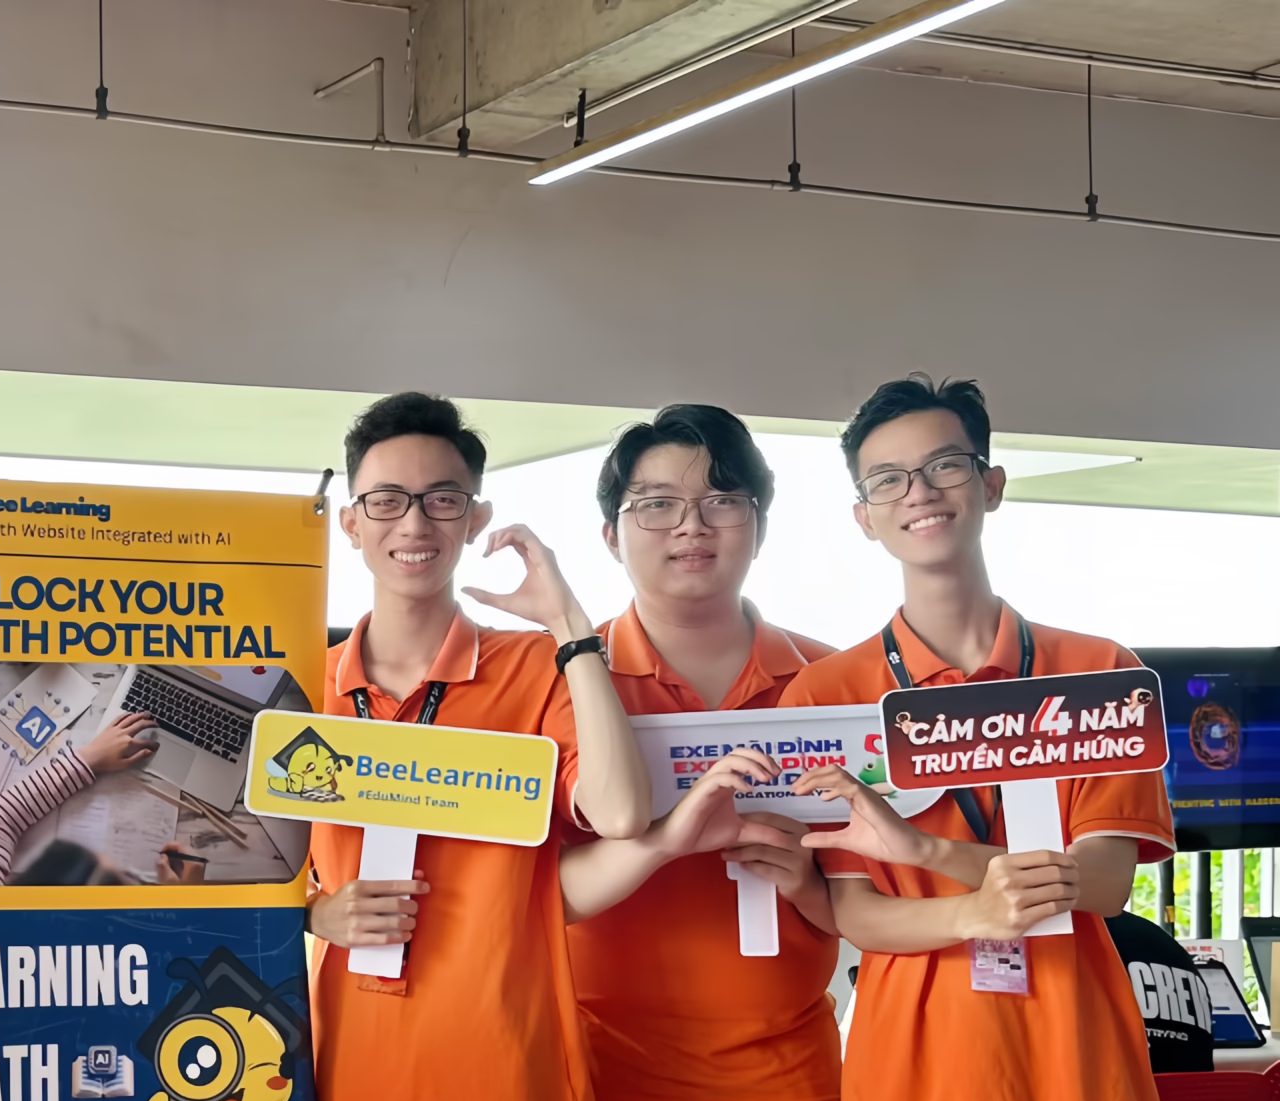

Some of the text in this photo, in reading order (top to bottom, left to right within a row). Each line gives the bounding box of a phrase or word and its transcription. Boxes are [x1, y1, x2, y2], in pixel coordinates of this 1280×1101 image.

[20, 496, 111, 522] Learning
[22, 523, 86, 540] Website
[91, 526, 172, 545] Integrated
[177, 531, 210, 545] with
[216, 532, 231, 545] AI
[109, 579, 224, 616] YOUR
[59, 621, 286, 659] POTENTIAL
[21, 716, 51, 743] AI
[909, 696, 1145, 745] CẢM ƠN 4 NĂM
[670, 744, 718, 759] EXE
[1073, 734, 1145, 761] HỨNG
[356, 755, 541, 800] BeeLearning
[425, 796, 459, 808] Team
[95, 1053, 111, 1065] AI
